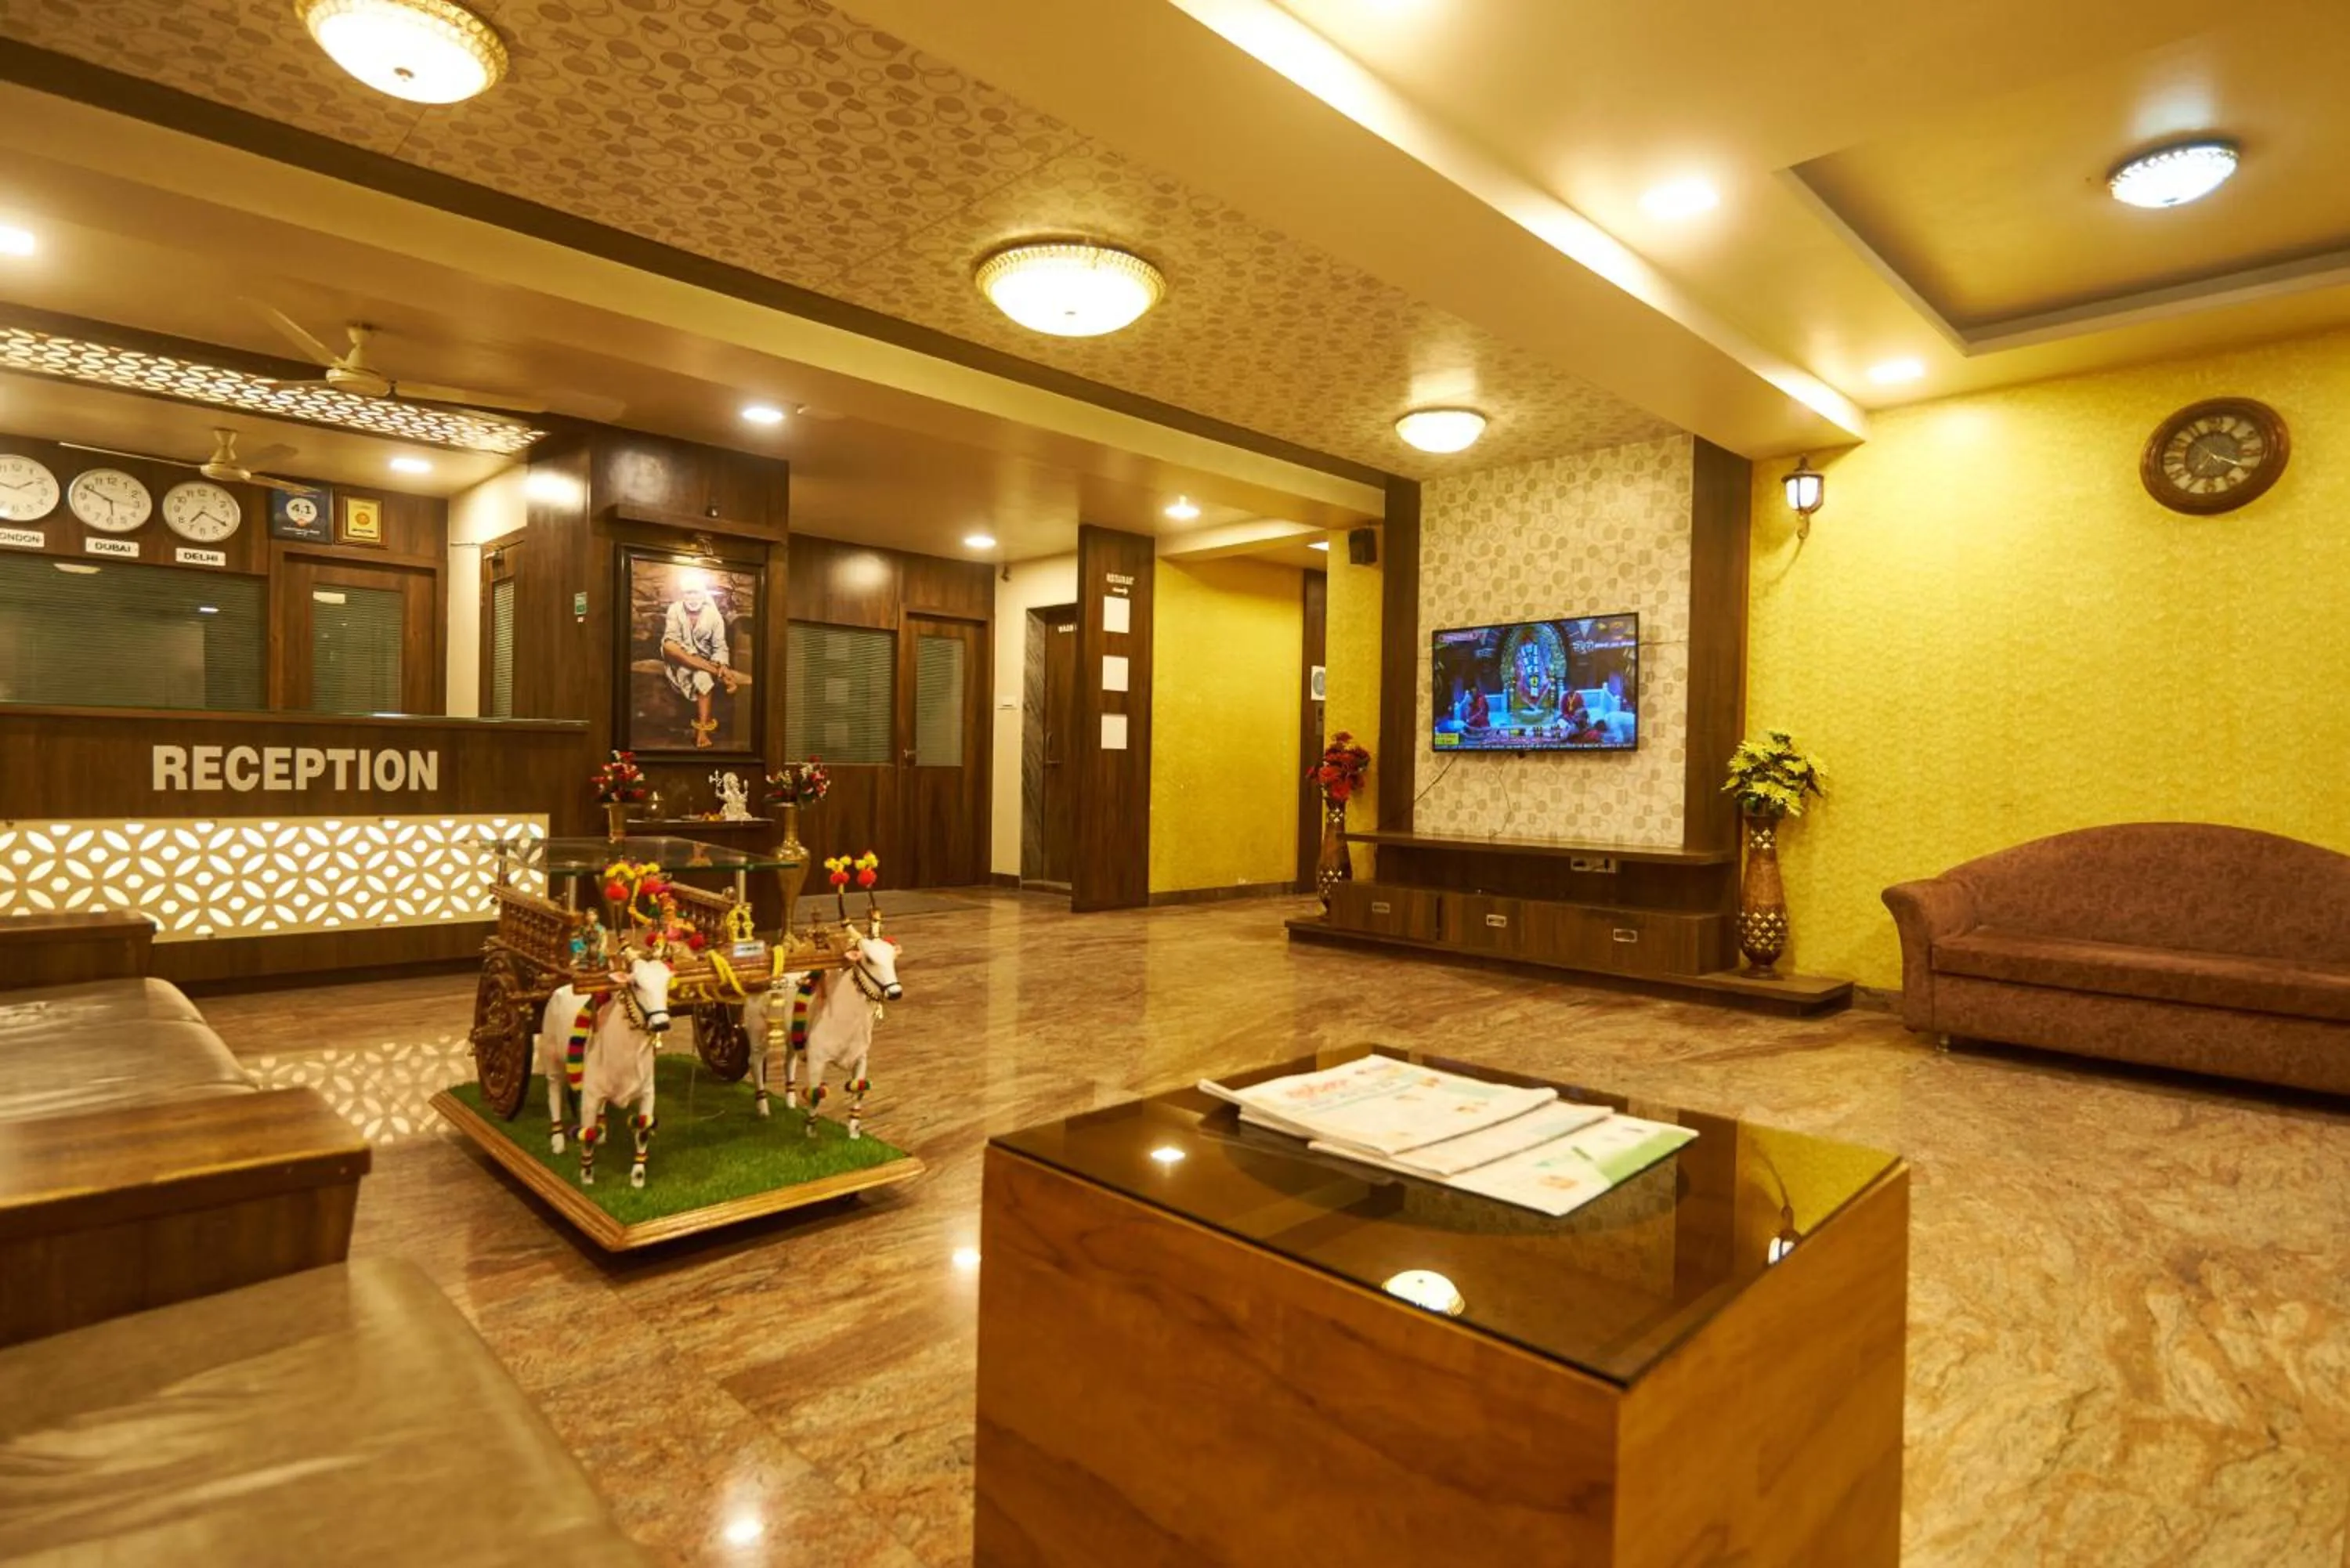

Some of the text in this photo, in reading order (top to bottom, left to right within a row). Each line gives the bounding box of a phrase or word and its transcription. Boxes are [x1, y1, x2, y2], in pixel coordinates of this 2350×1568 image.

[291, 503, 311, 515] 4.1
[0, 533, 39, 543] ONDON
[95, 541, 131, 552] DUBAI
[183, 551, 219, 562] DELHI
[153, 745, 438, 791] RECEPTION
